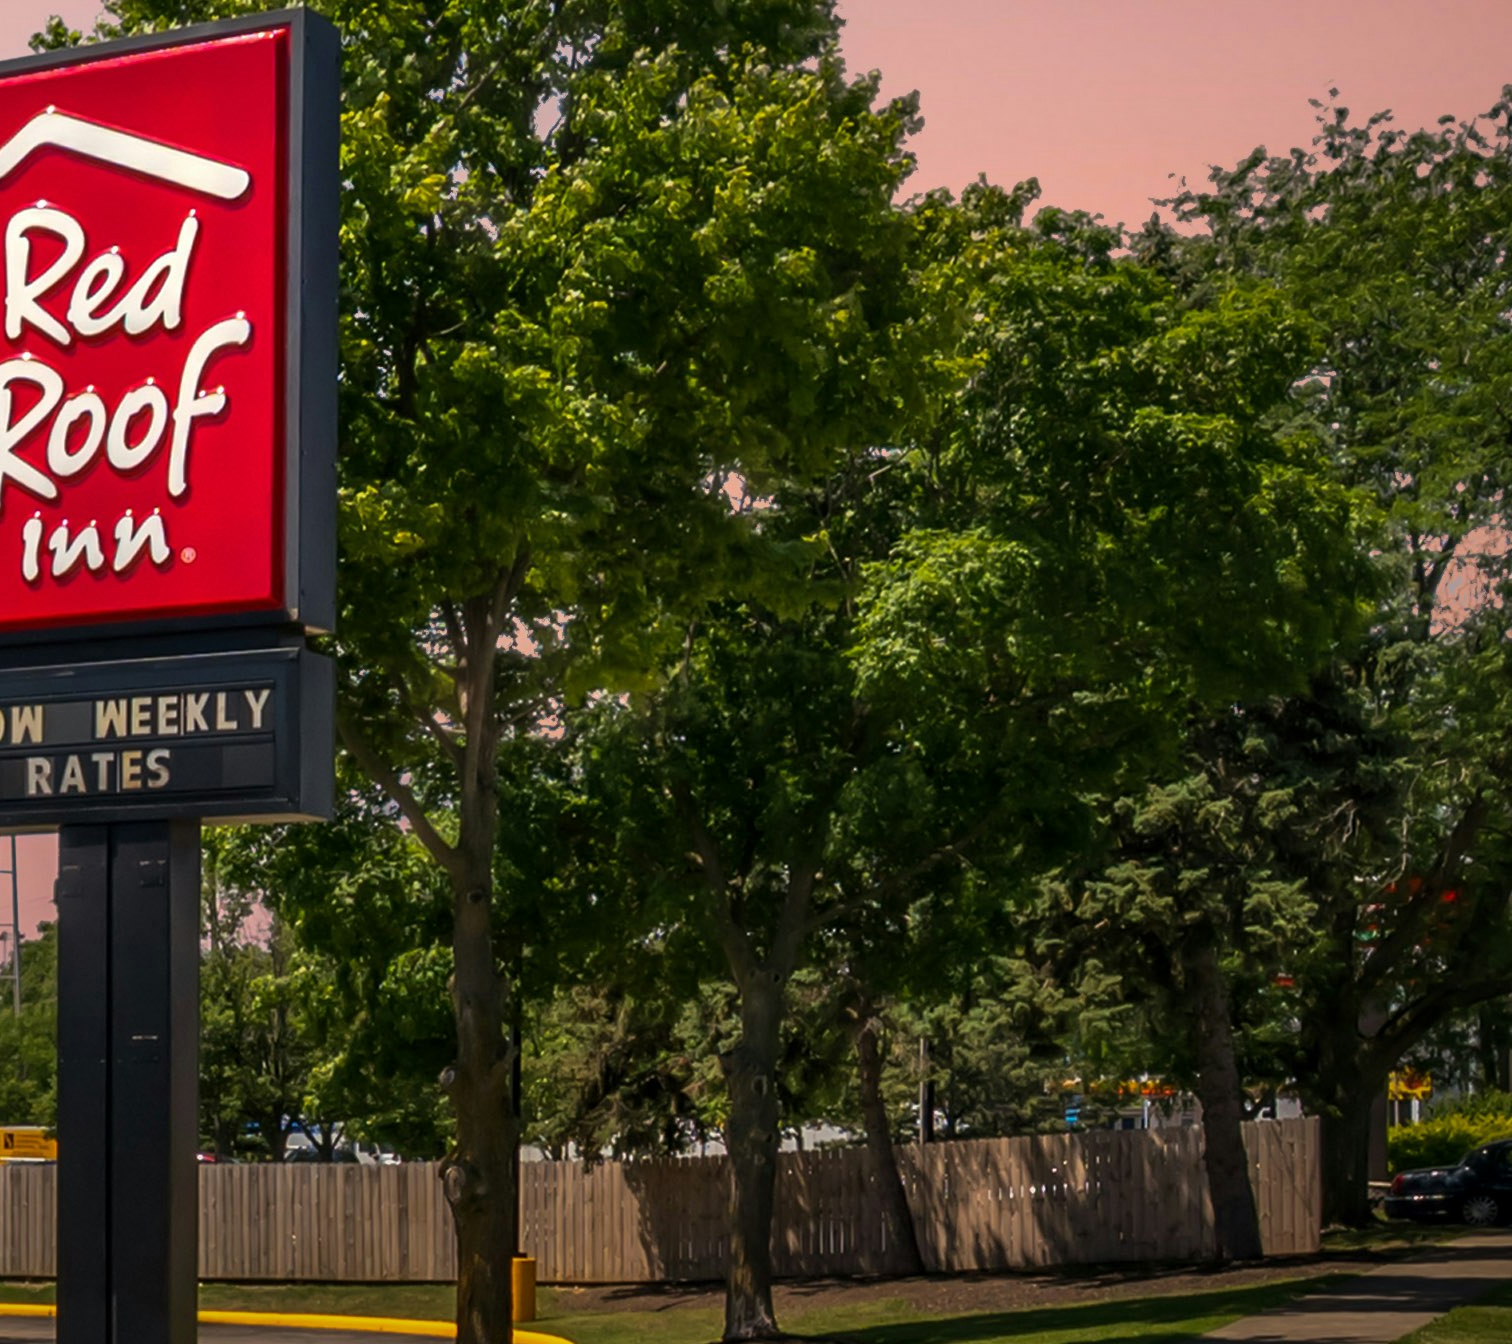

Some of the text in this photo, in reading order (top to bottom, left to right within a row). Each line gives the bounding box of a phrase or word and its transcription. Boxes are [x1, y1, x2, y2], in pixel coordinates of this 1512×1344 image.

[4, 199, 199, 345] Red
[95, 689, 270, 739] WEEKLY
[27, 749, 170, 795] RATES
